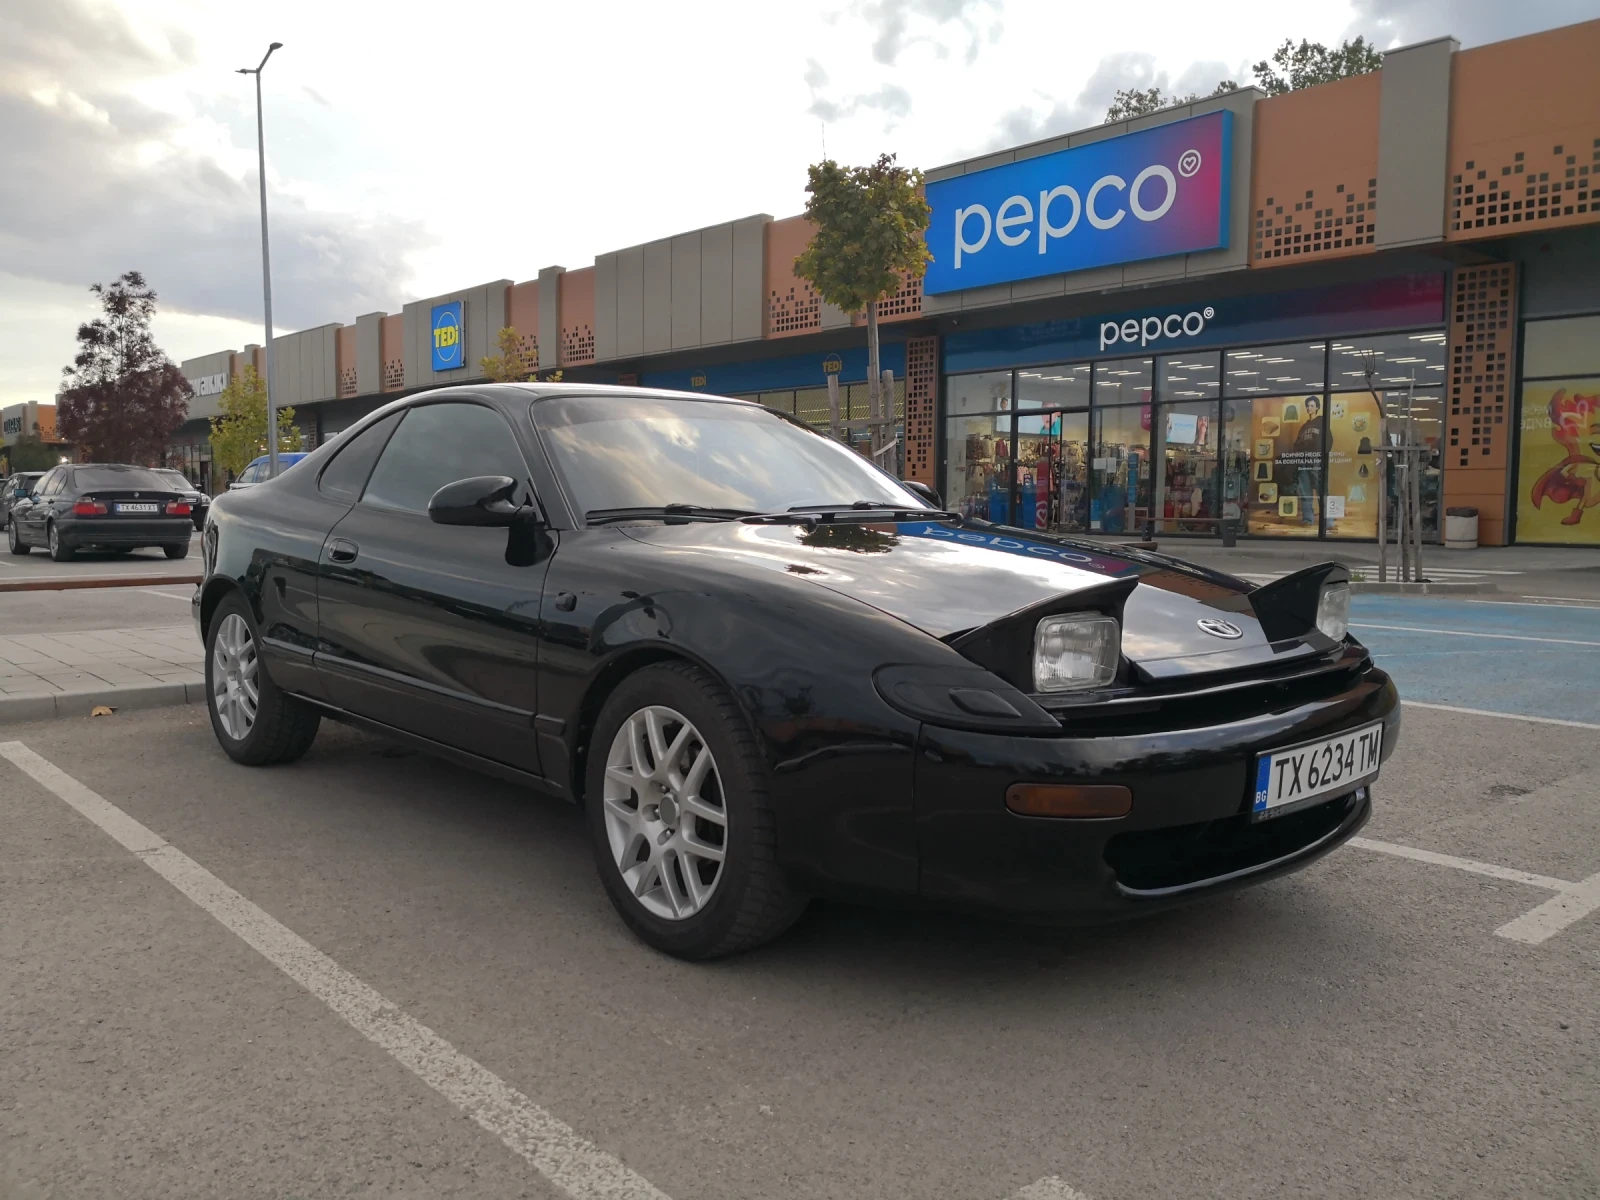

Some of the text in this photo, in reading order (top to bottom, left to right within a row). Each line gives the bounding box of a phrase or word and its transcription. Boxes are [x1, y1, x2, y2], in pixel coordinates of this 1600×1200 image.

[954, 164, 1177, 270] pepco
[433, 324, 459, 348] TEDi
[1100, 311, 1204, 351] pepco
[822, 360, 843, 373] TEDi
[691, 375, 707, 387] TEDi
[1275, 729, 1380, 799] TX 6234 TM
[1255, 790, 1267, 804] BG
